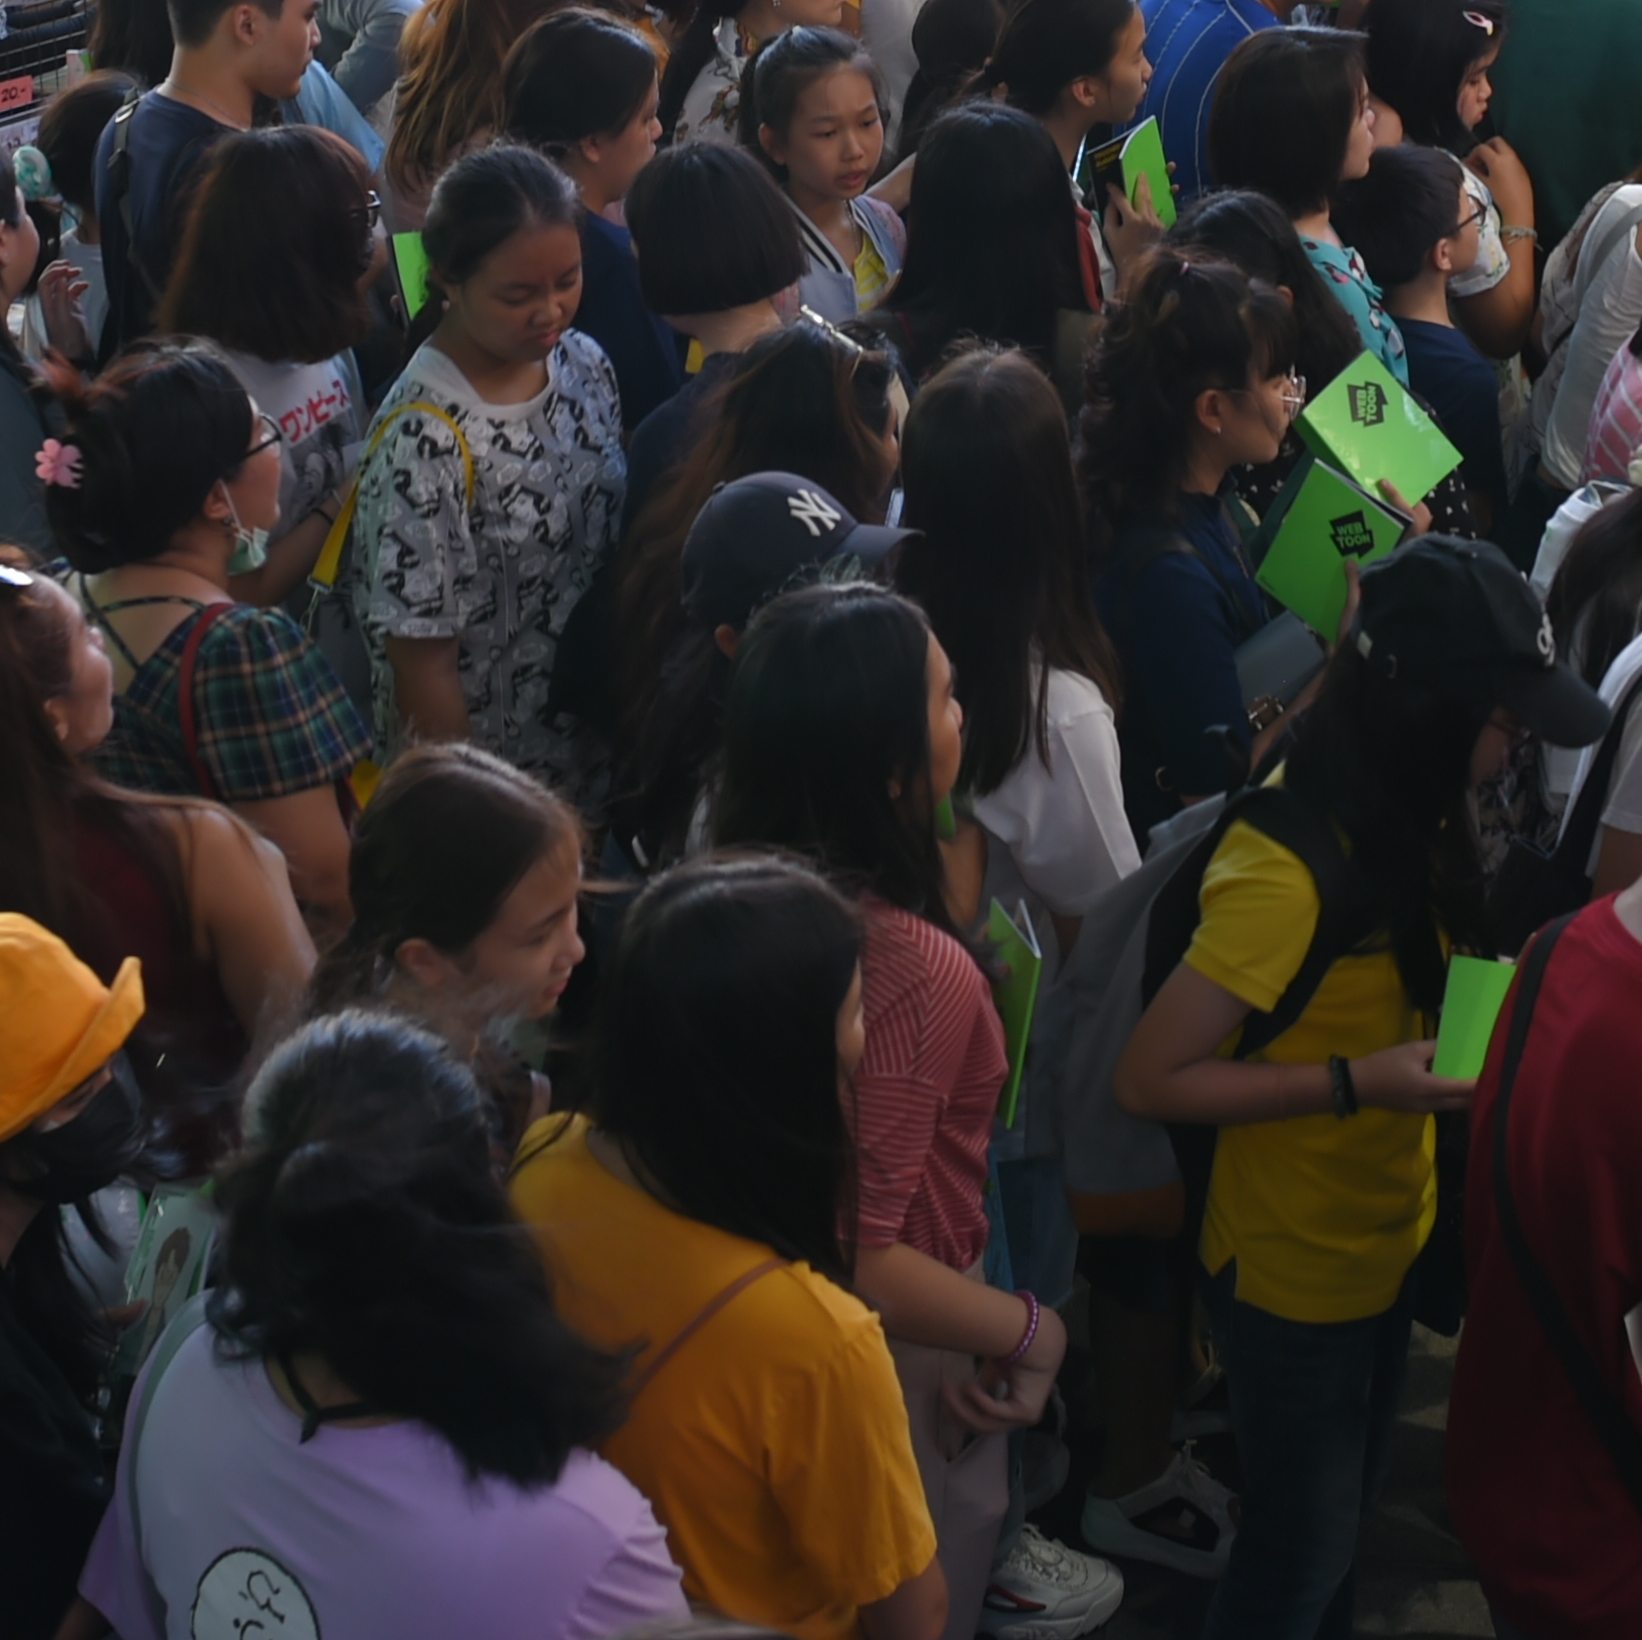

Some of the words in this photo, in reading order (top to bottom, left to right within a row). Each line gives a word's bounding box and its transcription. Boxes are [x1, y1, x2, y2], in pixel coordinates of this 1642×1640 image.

[787, 488, 842, 537] NY
[1336, 521, 1364, 537] WEB
[1335, 531, 1373, 549] TOON
